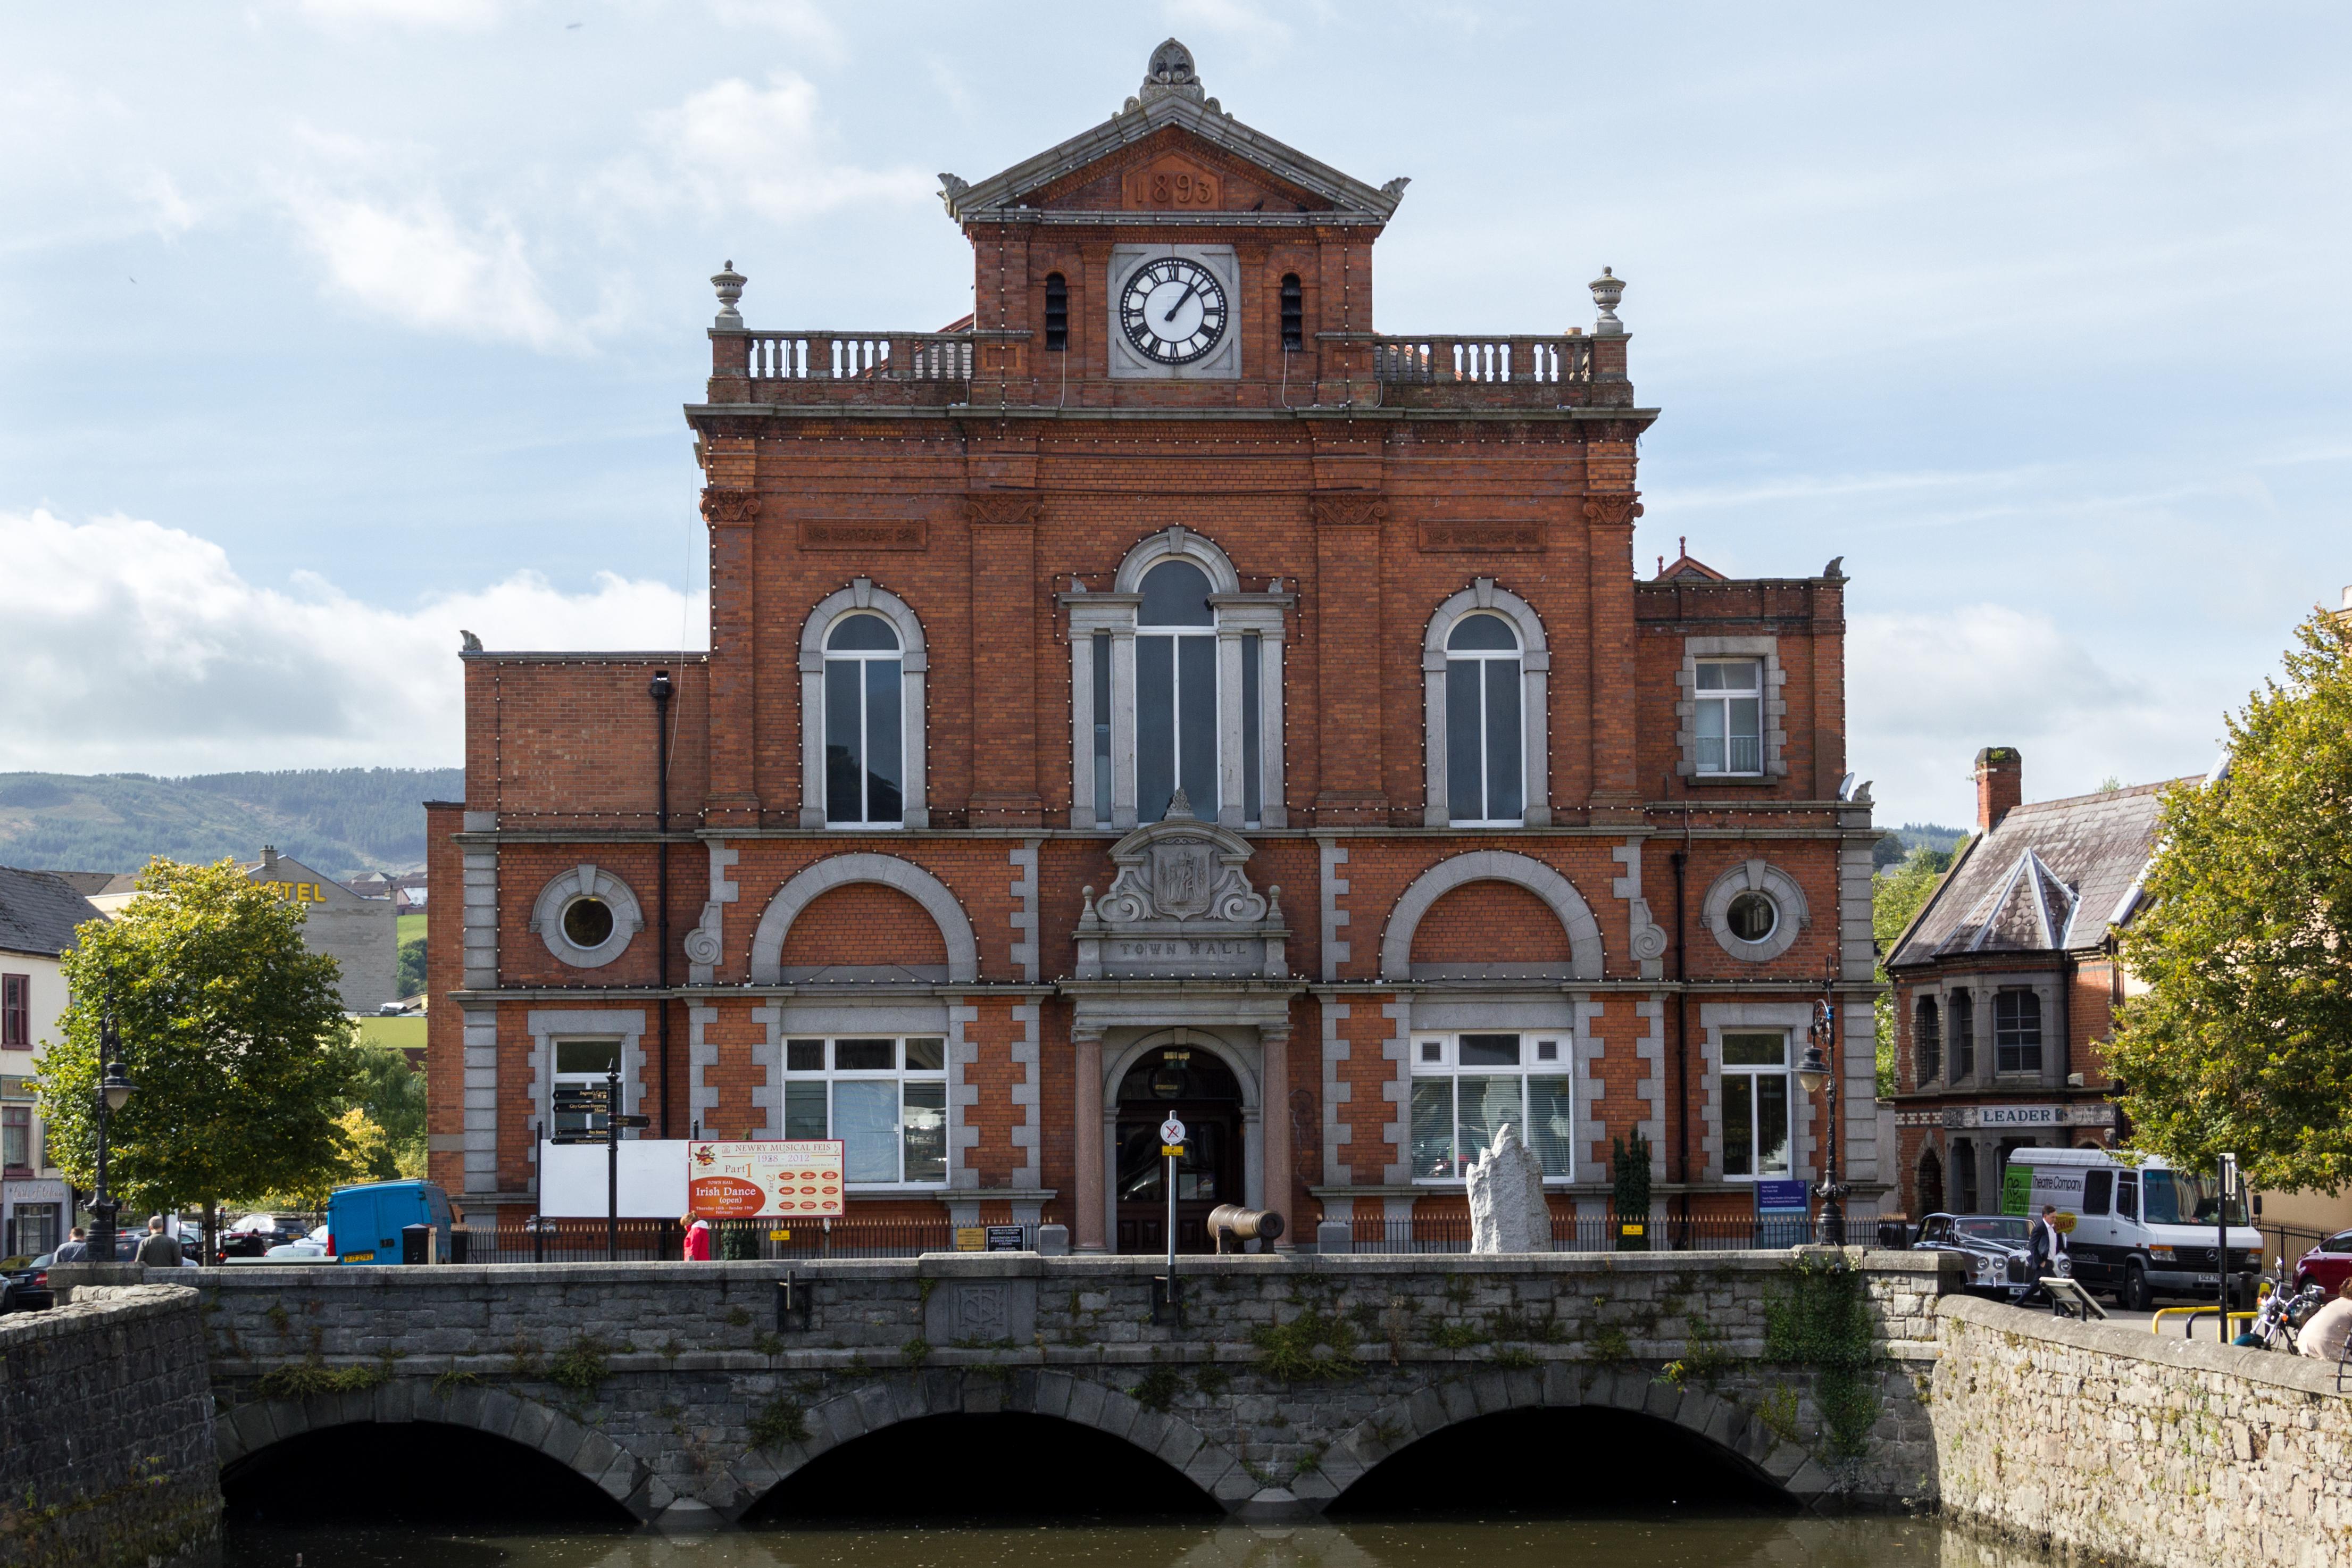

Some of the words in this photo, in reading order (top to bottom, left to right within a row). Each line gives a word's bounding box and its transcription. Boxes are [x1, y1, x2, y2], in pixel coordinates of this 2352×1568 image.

[1136, 174, 1212, 203] 1893
[1120, 943, 1177, 955] TOWN
[1189, 943, 1246, 955] HALL
[1983, 1107, 2051, 1122] LEADER
[746, 1163, 753, 1178] 1
[2032, 1175, 2054, 1189] Theatre
[2053, 1175, 2082, 1192] Company
[696, 1187, 720, 1196] Irish
[723, 1187, 756, 1196] Dance
